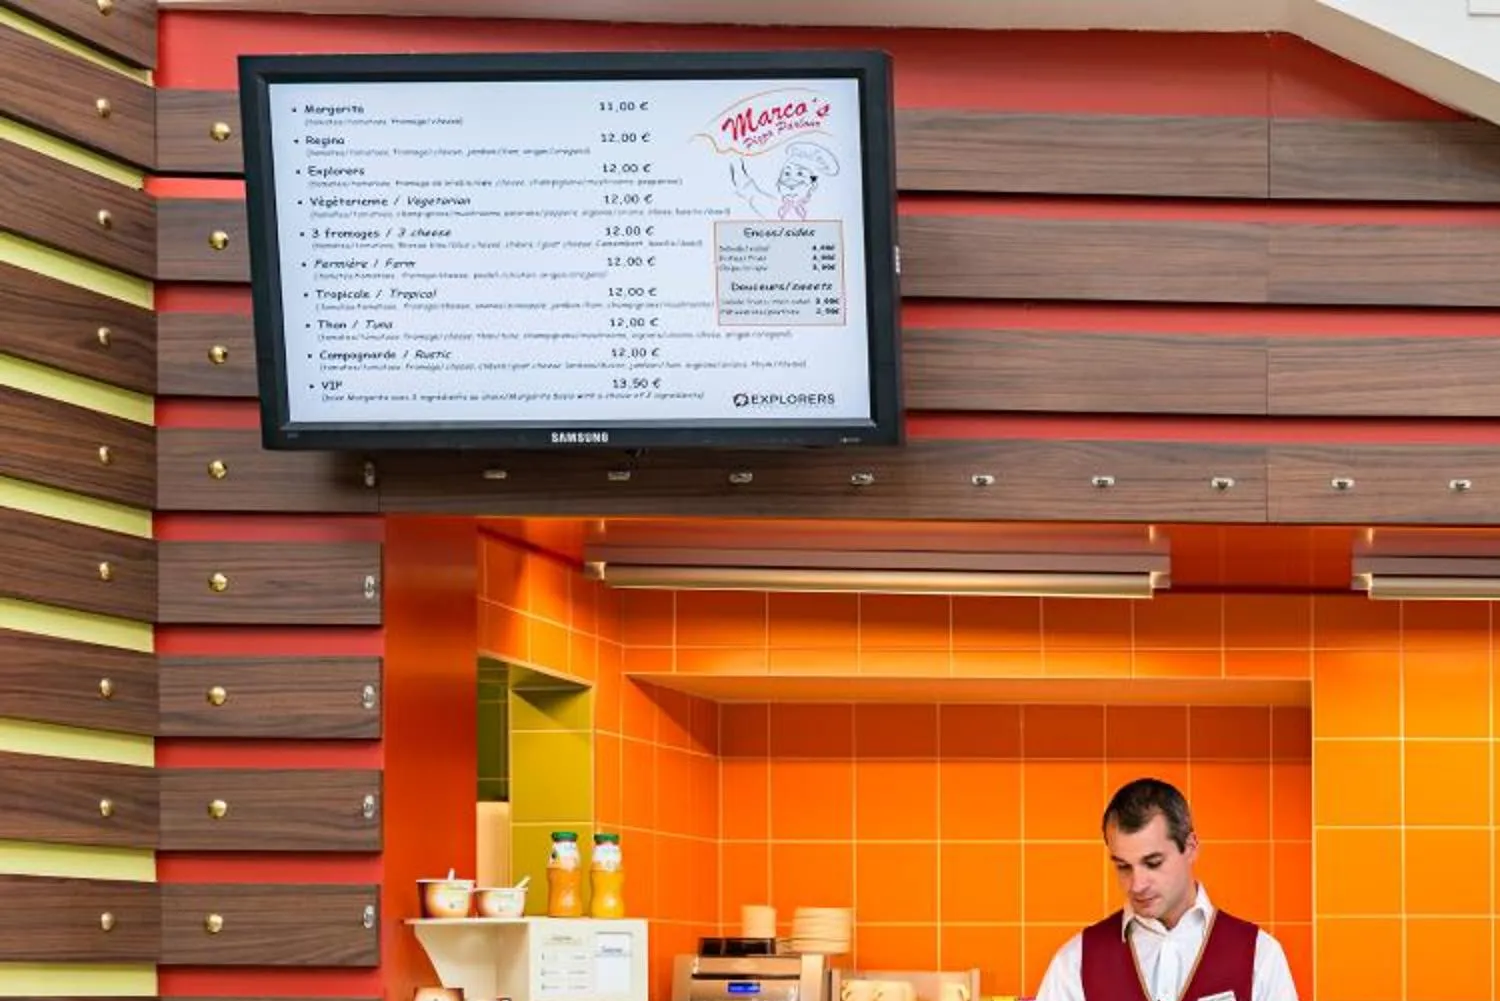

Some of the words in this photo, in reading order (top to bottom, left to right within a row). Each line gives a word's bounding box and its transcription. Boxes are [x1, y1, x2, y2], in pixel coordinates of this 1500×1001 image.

[639, 101, 649, 111] €
[641, 133, 651, 143] €
[307, 165, 365, 178] Explorers
[643, 163, 652, 174] €
[644, 194, 654, 205] €
[311, 228, 320, 239] 3
[325, 227, 381, 241] fromages
[410, 227, 452, 238] cheese
[645, 226, 655, 237] €
[647, 256, 657, 267] €
[389, 289, 437, 301] Tropical
[648, 287, 658, 298] €
[650, 317, 659, 328] €
[651, 348, 660, 358] €
[652, 378, 662, 389] €
[751, 394, 836, 406] EXPLORERS
[550, 431, 609, 444] SAMSUNG
